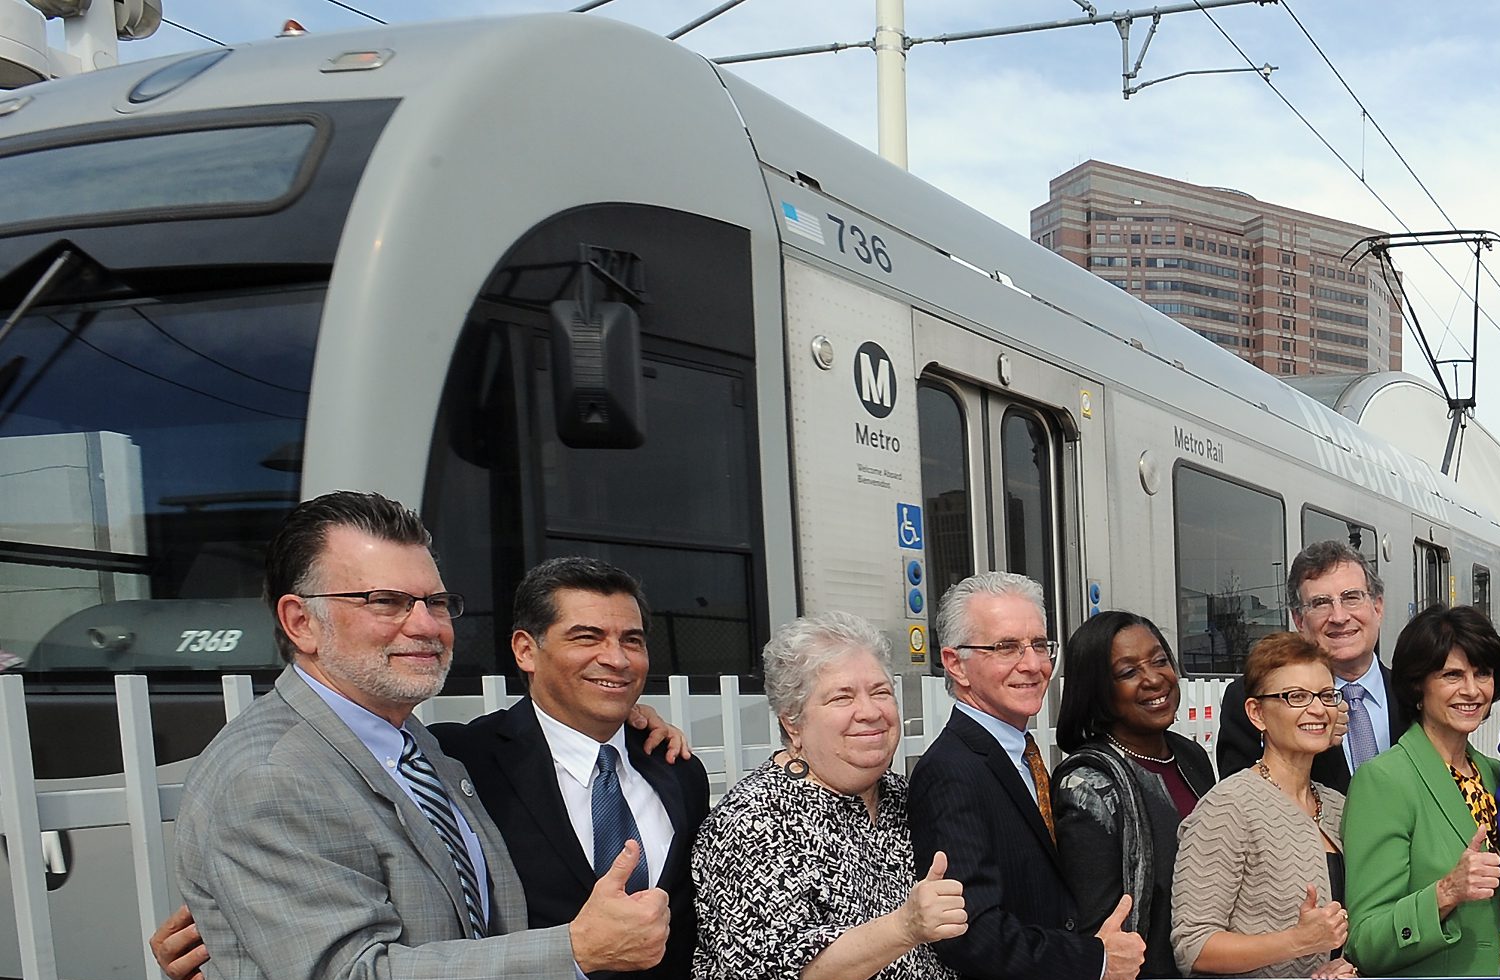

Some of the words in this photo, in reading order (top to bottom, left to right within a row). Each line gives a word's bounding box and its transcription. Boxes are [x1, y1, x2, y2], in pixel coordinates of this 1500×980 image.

[827, 213, 893, 274] 736
[855, 422, 901, 453] Metro
[1173, 425, 1205, 457] Metro
[1206, 438, 1224, 464] Rail
[175, 630, 244, 652] 736B
